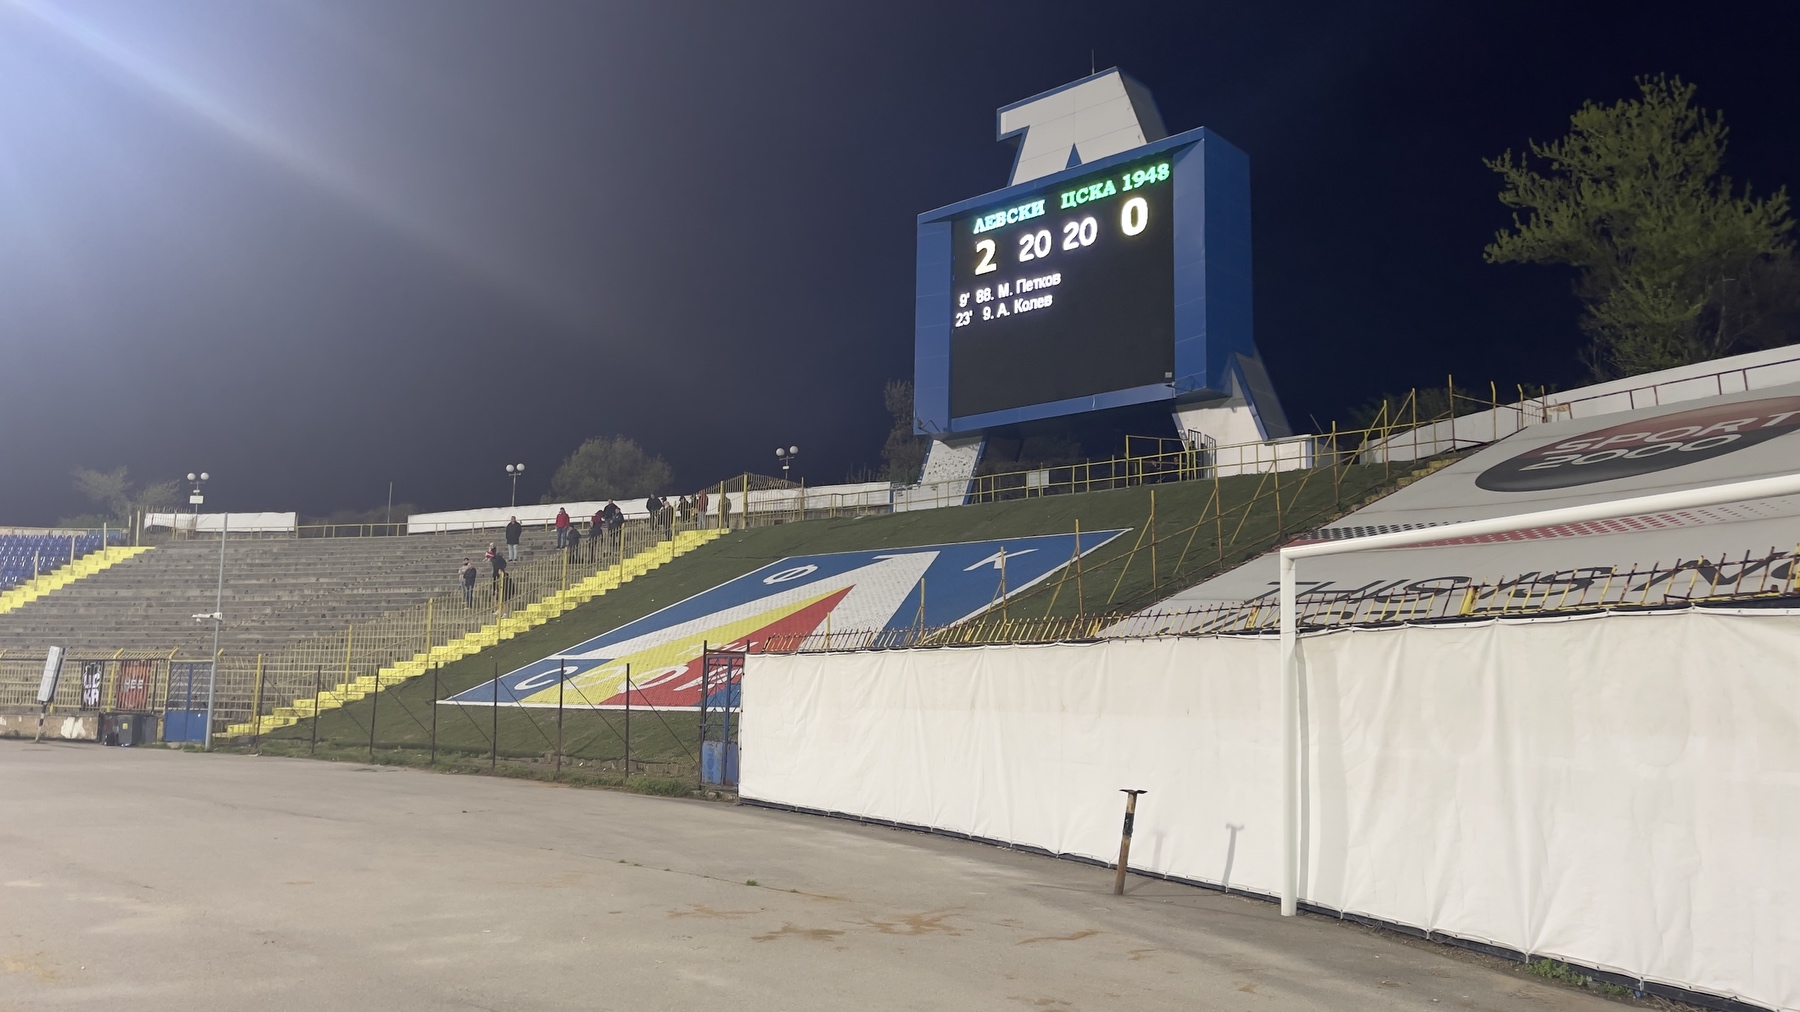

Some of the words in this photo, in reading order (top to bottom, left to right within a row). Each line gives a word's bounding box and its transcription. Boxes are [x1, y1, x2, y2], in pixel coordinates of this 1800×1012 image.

[1061, 180, 1117, 210] ЦСКА
[1122, 163, 1171, 192] 1948
[973, 199, 1046, 235] ЛЕВСКИ
[974, 239, 998, 275] 2
[1019, 229, 1053, 262] 20
[1062, 217, 1098, 251] 20
[1121, 197, 1149, 236] 0
[976, 287, 994, 304] 88.
[998, 283, 1013, 298] М.
[1016, 273, 1062, 294] Петков
[955, 310, 973, 328] 23'
[983, 307, 994, 321] 9.
[997, 302, 1010, 318] А.
[1014, 295, 1053, 314] Колев
[1519, 433, 1742, 471] 2000
[1542, 411, 1800, 455] SPORT
